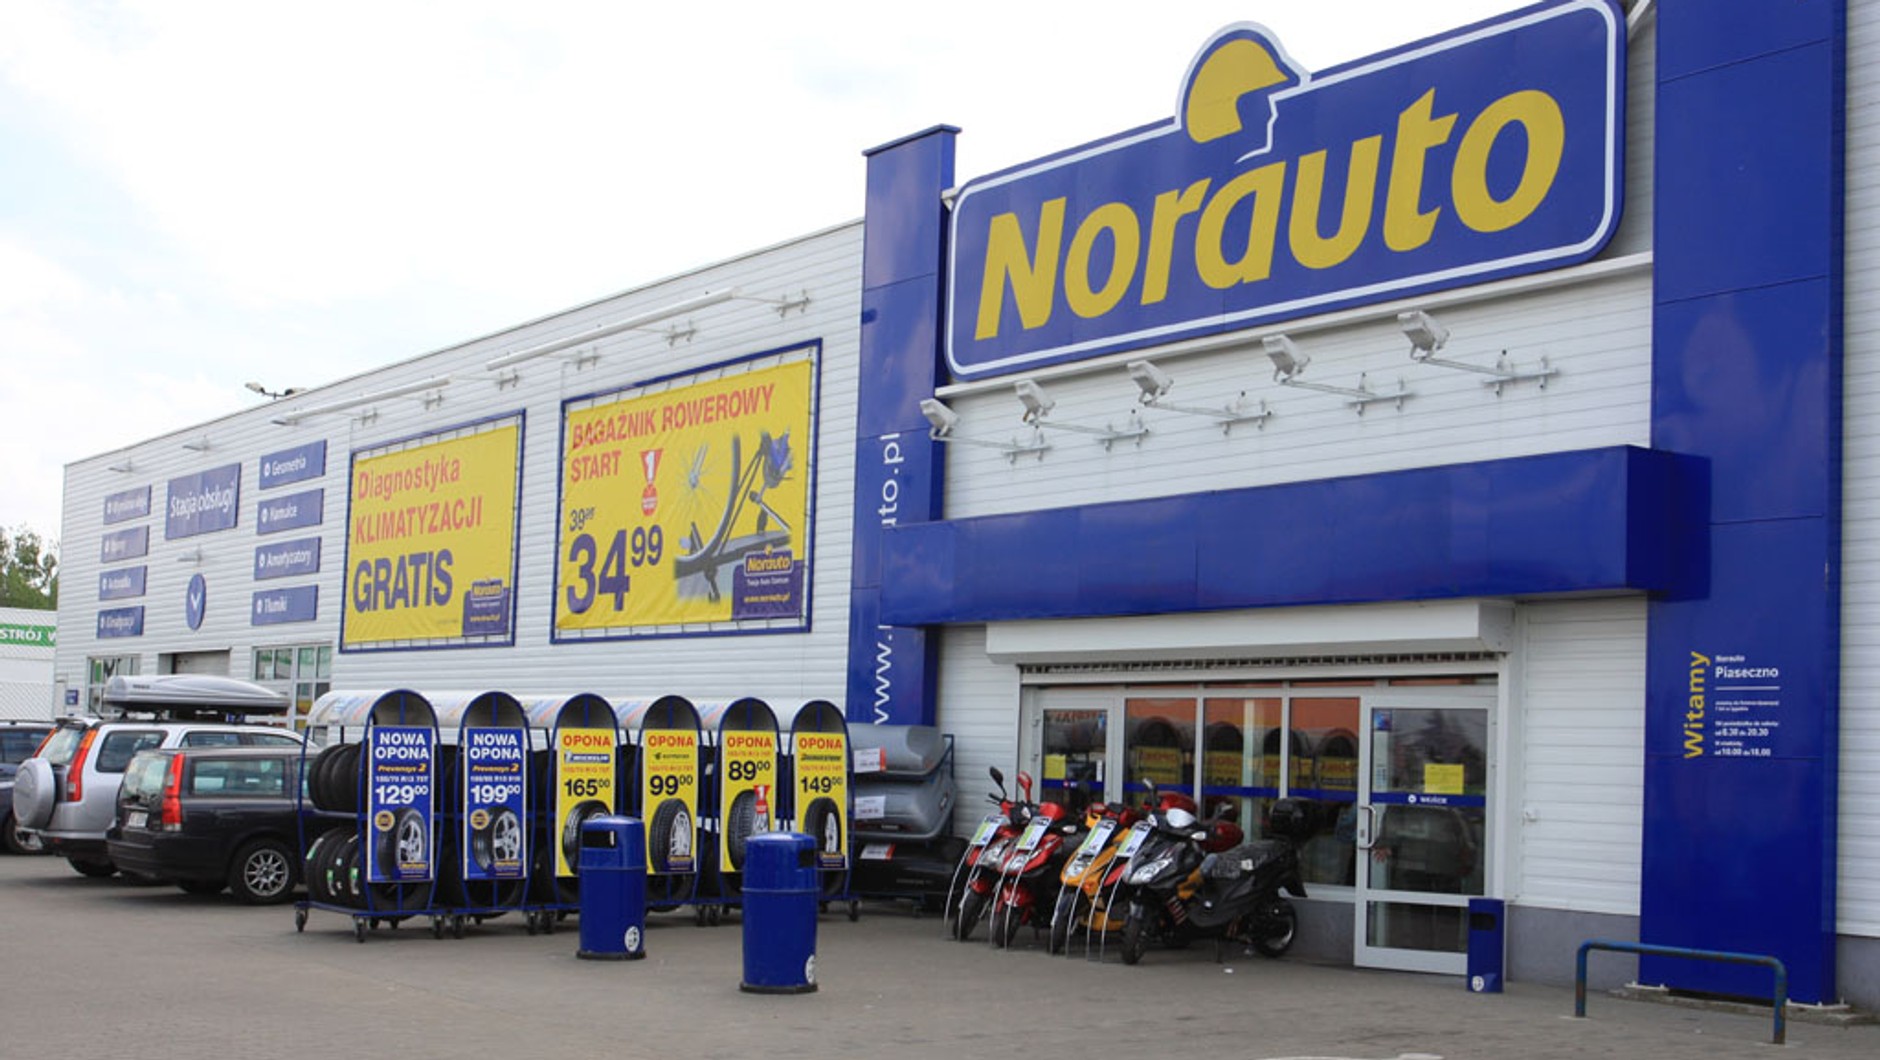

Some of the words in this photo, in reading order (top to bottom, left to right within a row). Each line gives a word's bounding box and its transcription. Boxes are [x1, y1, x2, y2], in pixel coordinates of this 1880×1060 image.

[974, 86, 1565, 341] Norauto
[572, 407, 656, 449] BAGAŻNIK
[661, 383, 775, 432] ROWEROWY
[271, 456, 307, 476] Geometria
[571, 449, 622, 483] START
[357, 454, 461, 501] Diagnostyka
[170, 491, 196, 520] Stacja
[355, 495, 483, 545] KLIMATYZACJI
[353, 549, 454, 614] GRATIS
[1715, 666, 1779, 679] Piaseczno
[1683, 651, 1711, 759] Witamy
[380, 733, 426, 746] NOWA
[473, 734, 518, 746] NOWA
[563, 735, 611, 747] OPONA
[648, 735, 694, 748] OPONA
[727, 736, 772, 748] OPONA
[799, 737, 842, 749] OPONA
[375, 747, 430, 759] OPONA
[470, 747, 522, 760] OPONA
